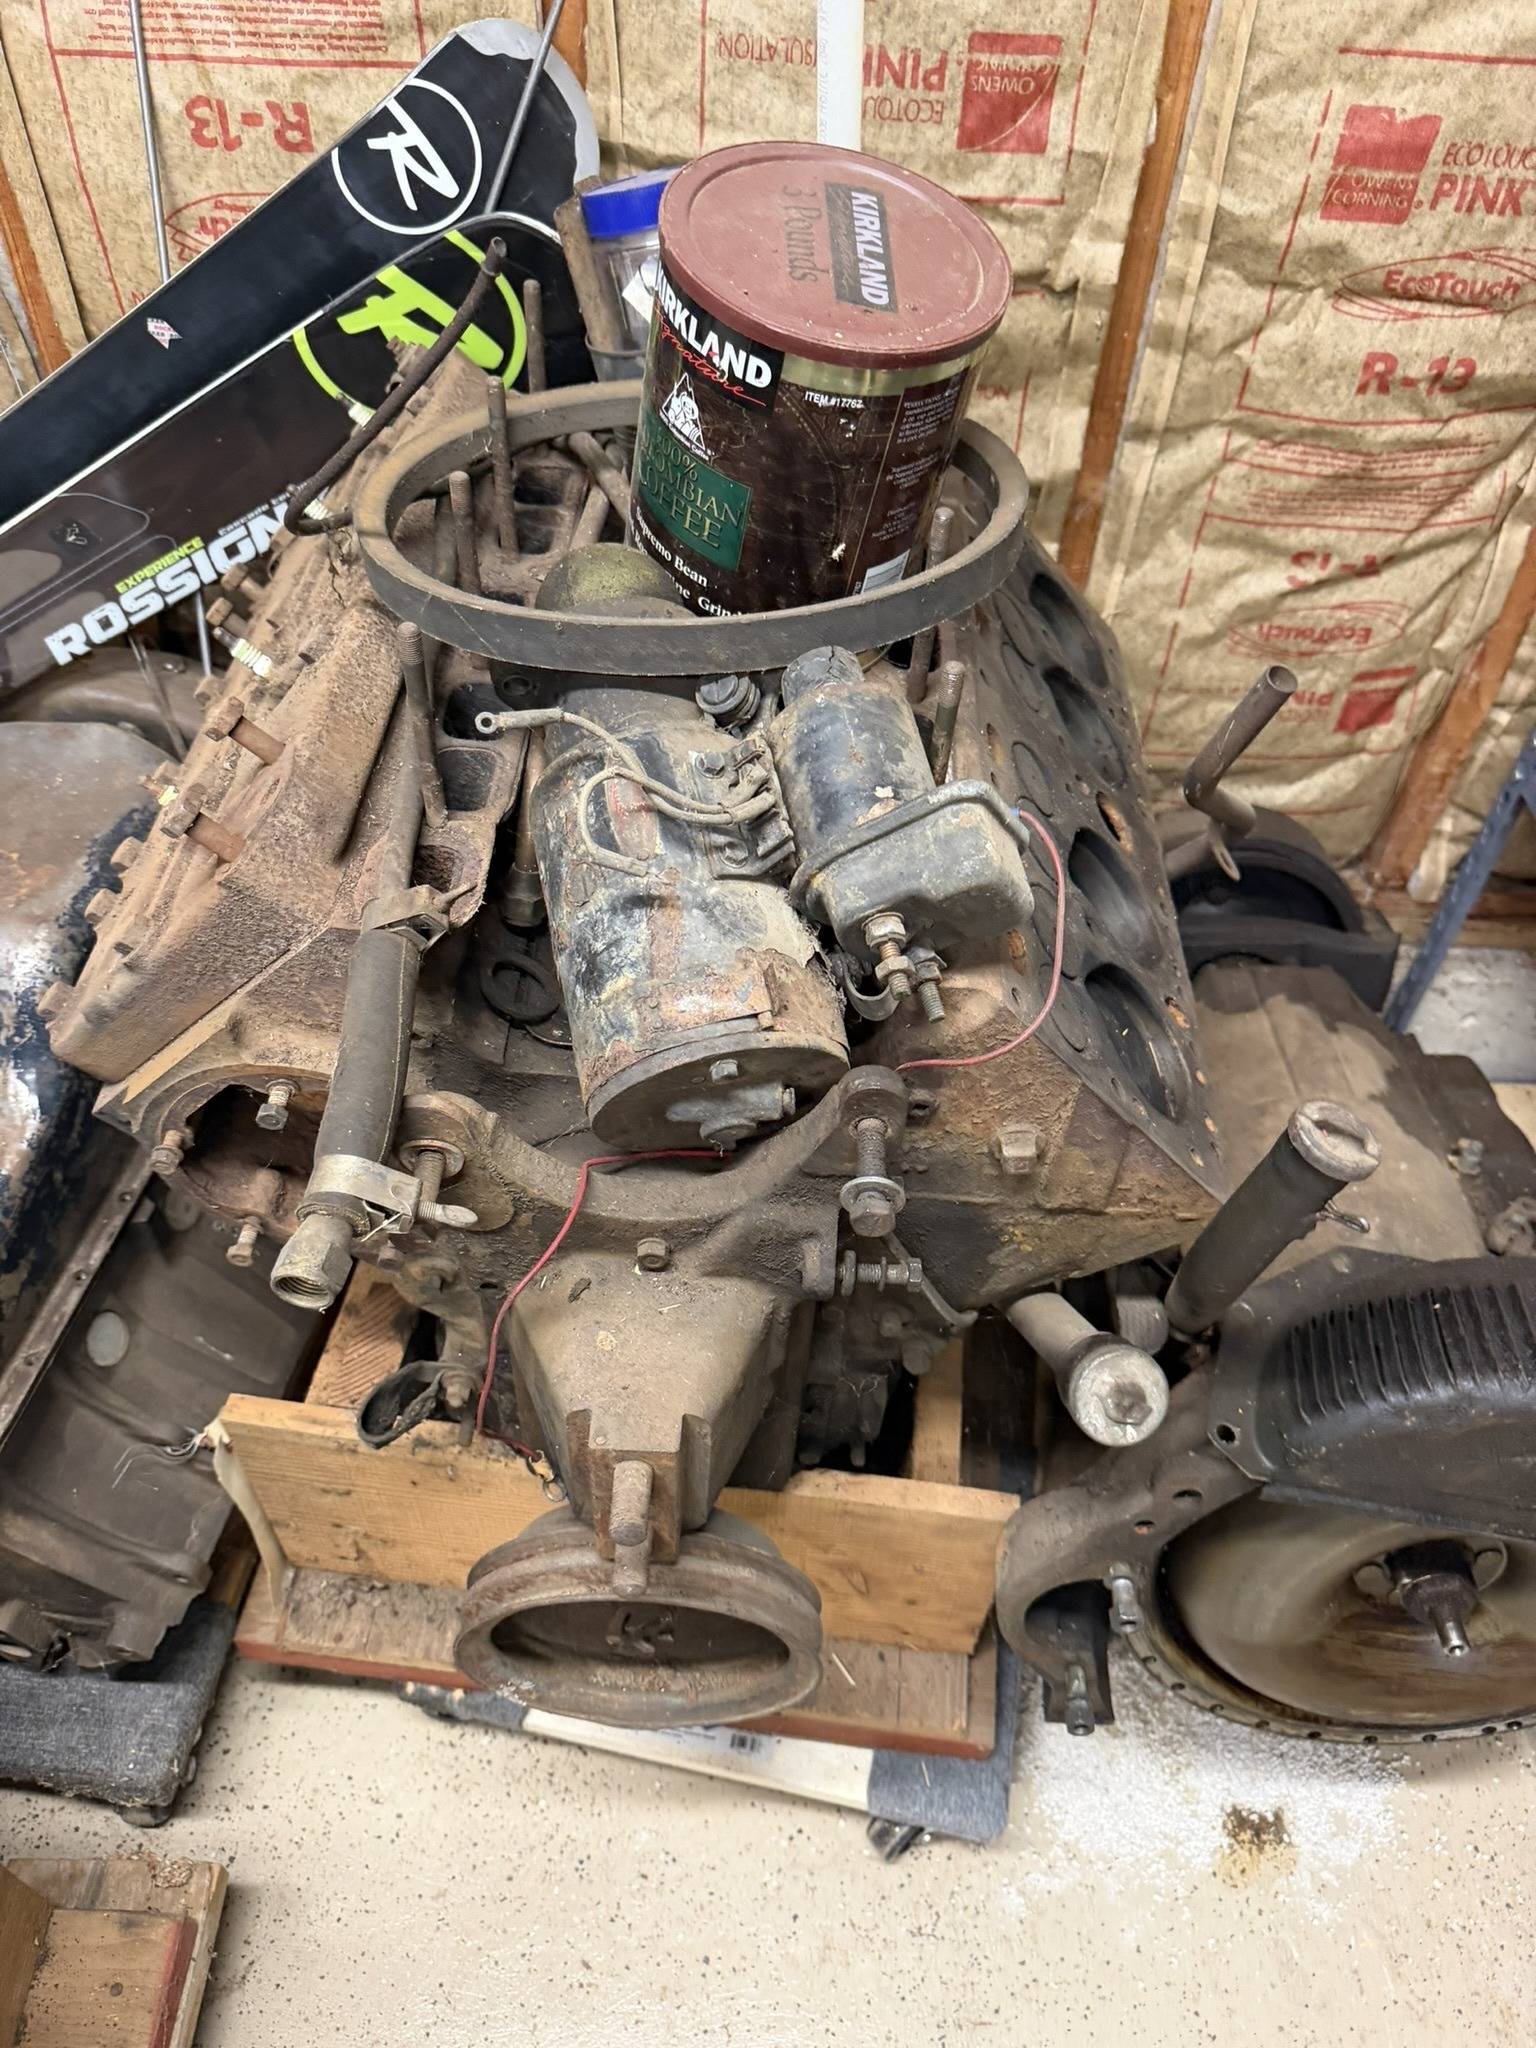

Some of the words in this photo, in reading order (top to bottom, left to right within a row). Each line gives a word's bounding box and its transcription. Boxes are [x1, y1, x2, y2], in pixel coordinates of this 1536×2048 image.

[718, 31, 817, 68] SULATION
[972, 76, 1035, 94] OWENS
[184, 94, 315, 152] R-13
[862, 96, 944, 123] ECOTOU
[1441, 142, 1536, 171] ECOTOUC
[1331, 188, 1409, 210] CORNING
[1429, 172, 1528, 218] PINK
[784, 206, 830, 282] Pounds
[851, 191, 890, 305] KIRKLAND
[1382, 269, 1521, 301] EcoTouch
[658, 266, 772, 389] KIRKLAND
[1354, 350, 1477, 398] R-13
[44, 501, 290, 667] ROSSIGN
[114, 536, 206, 595] EXPERIENCE
[674, 554, 708, 588] Bean
[697, 596, 743, 618] Grin
[1258, 623, 1373, 645] EcoTouch
